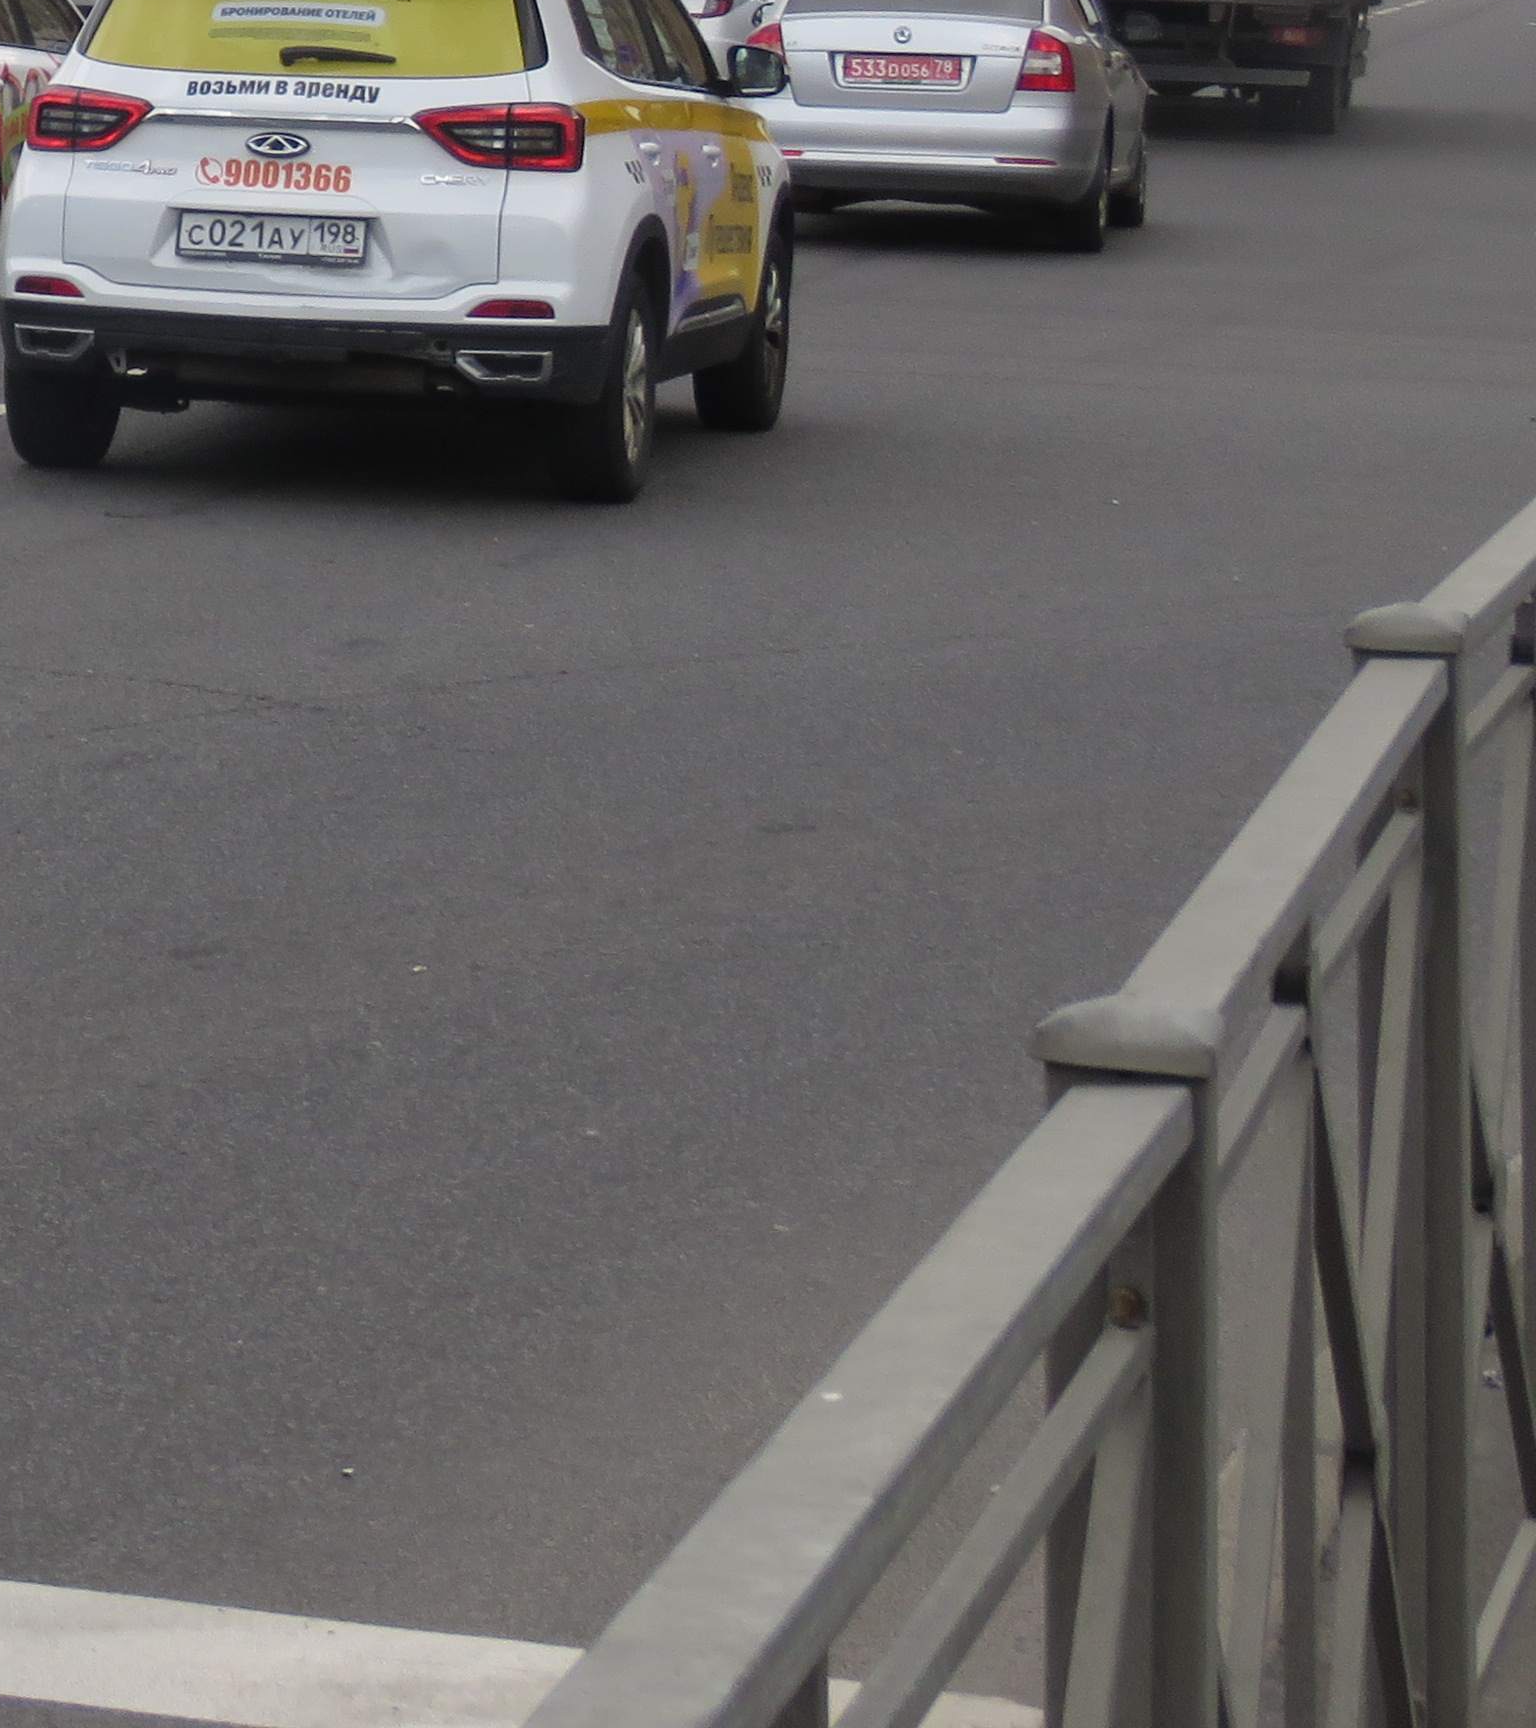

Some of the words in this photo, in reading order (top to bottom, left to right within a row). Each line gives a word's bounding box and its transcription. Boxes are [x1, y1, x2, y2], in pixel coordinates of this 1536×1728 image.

[219, 6, 323, 18] БРОНИРОВАНИЕ
[324, 8, 377, 22] ОТЕЛЕЙ
[934, 58, 953, 74] 78
[186, 79, 271, 97] возьми
[292, 80, 381, 104] аренду
[222, 158, 353, 193] 9001366
[313, 221, 357, 245] 198
